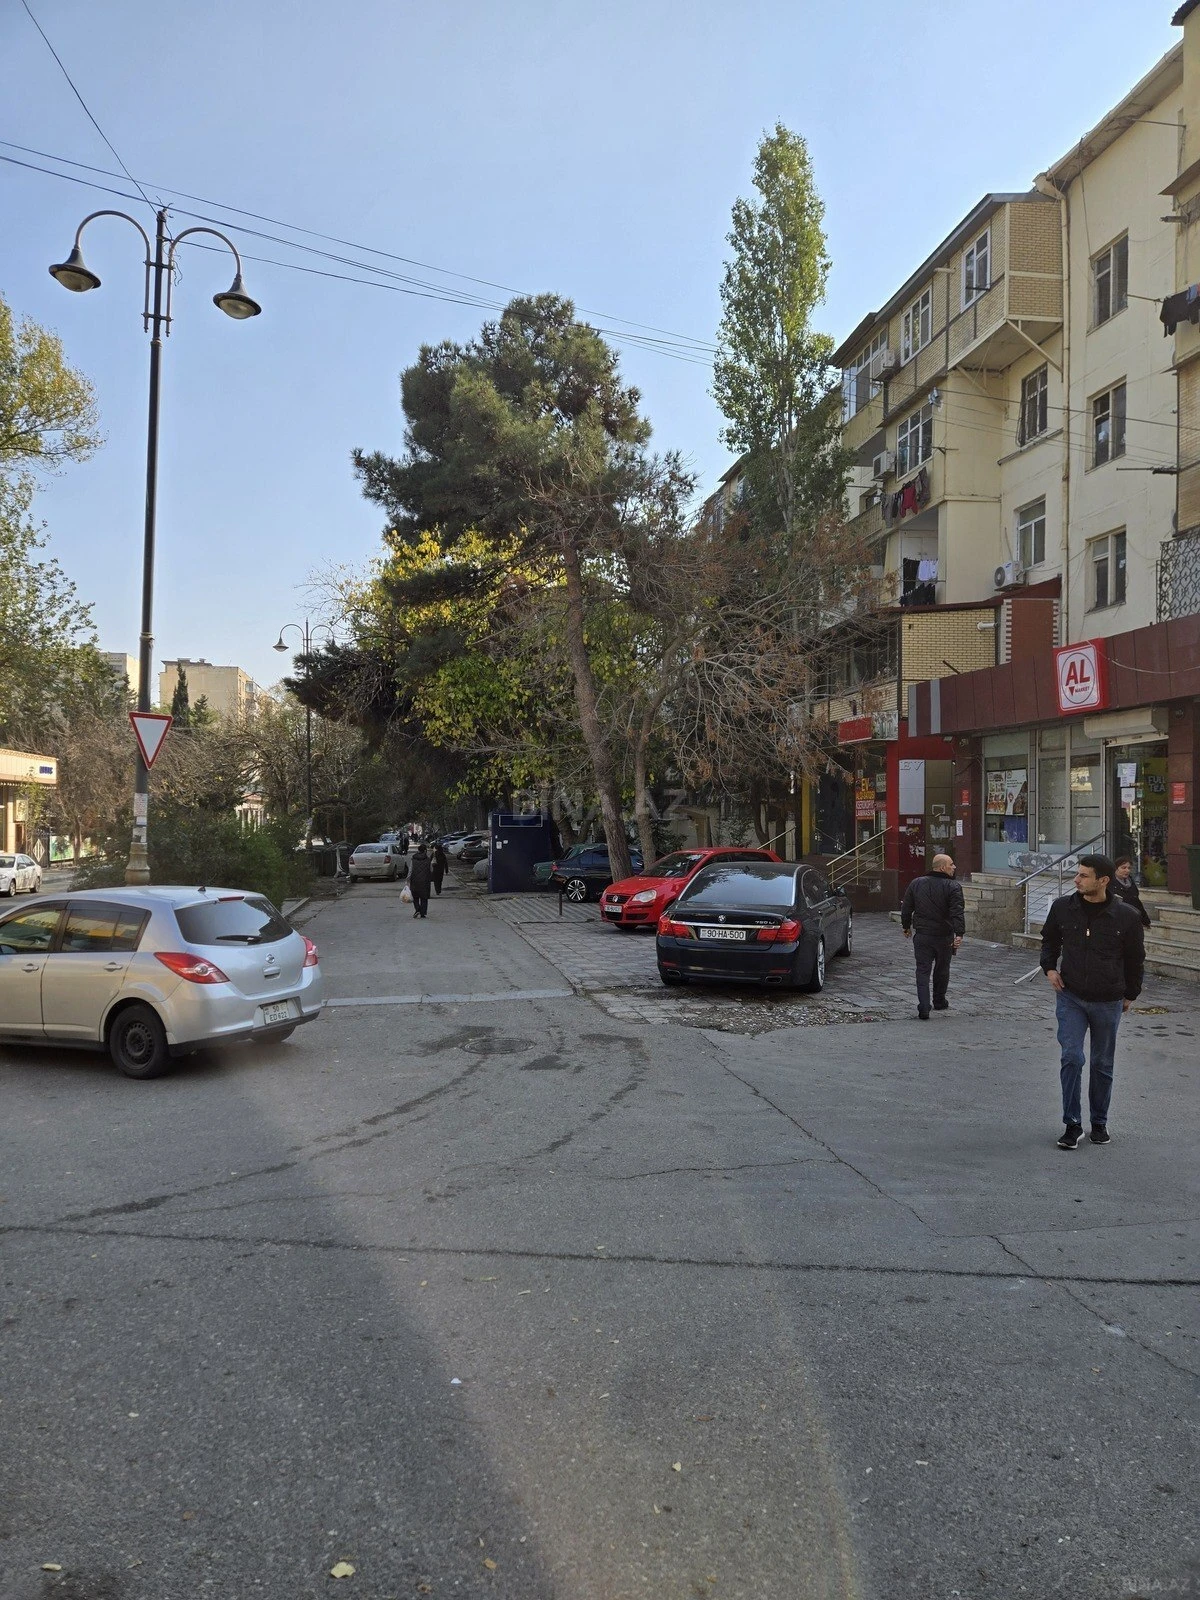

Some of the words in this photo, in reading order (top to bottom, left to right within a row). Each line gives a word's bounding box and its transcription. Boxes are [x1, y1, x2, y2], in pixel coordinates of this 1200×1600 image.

[1065, 659, 1090, 686] AL
[1149, 784, 1166, 792] TEA
[706, 929, 745, 940] 90-HA-500
